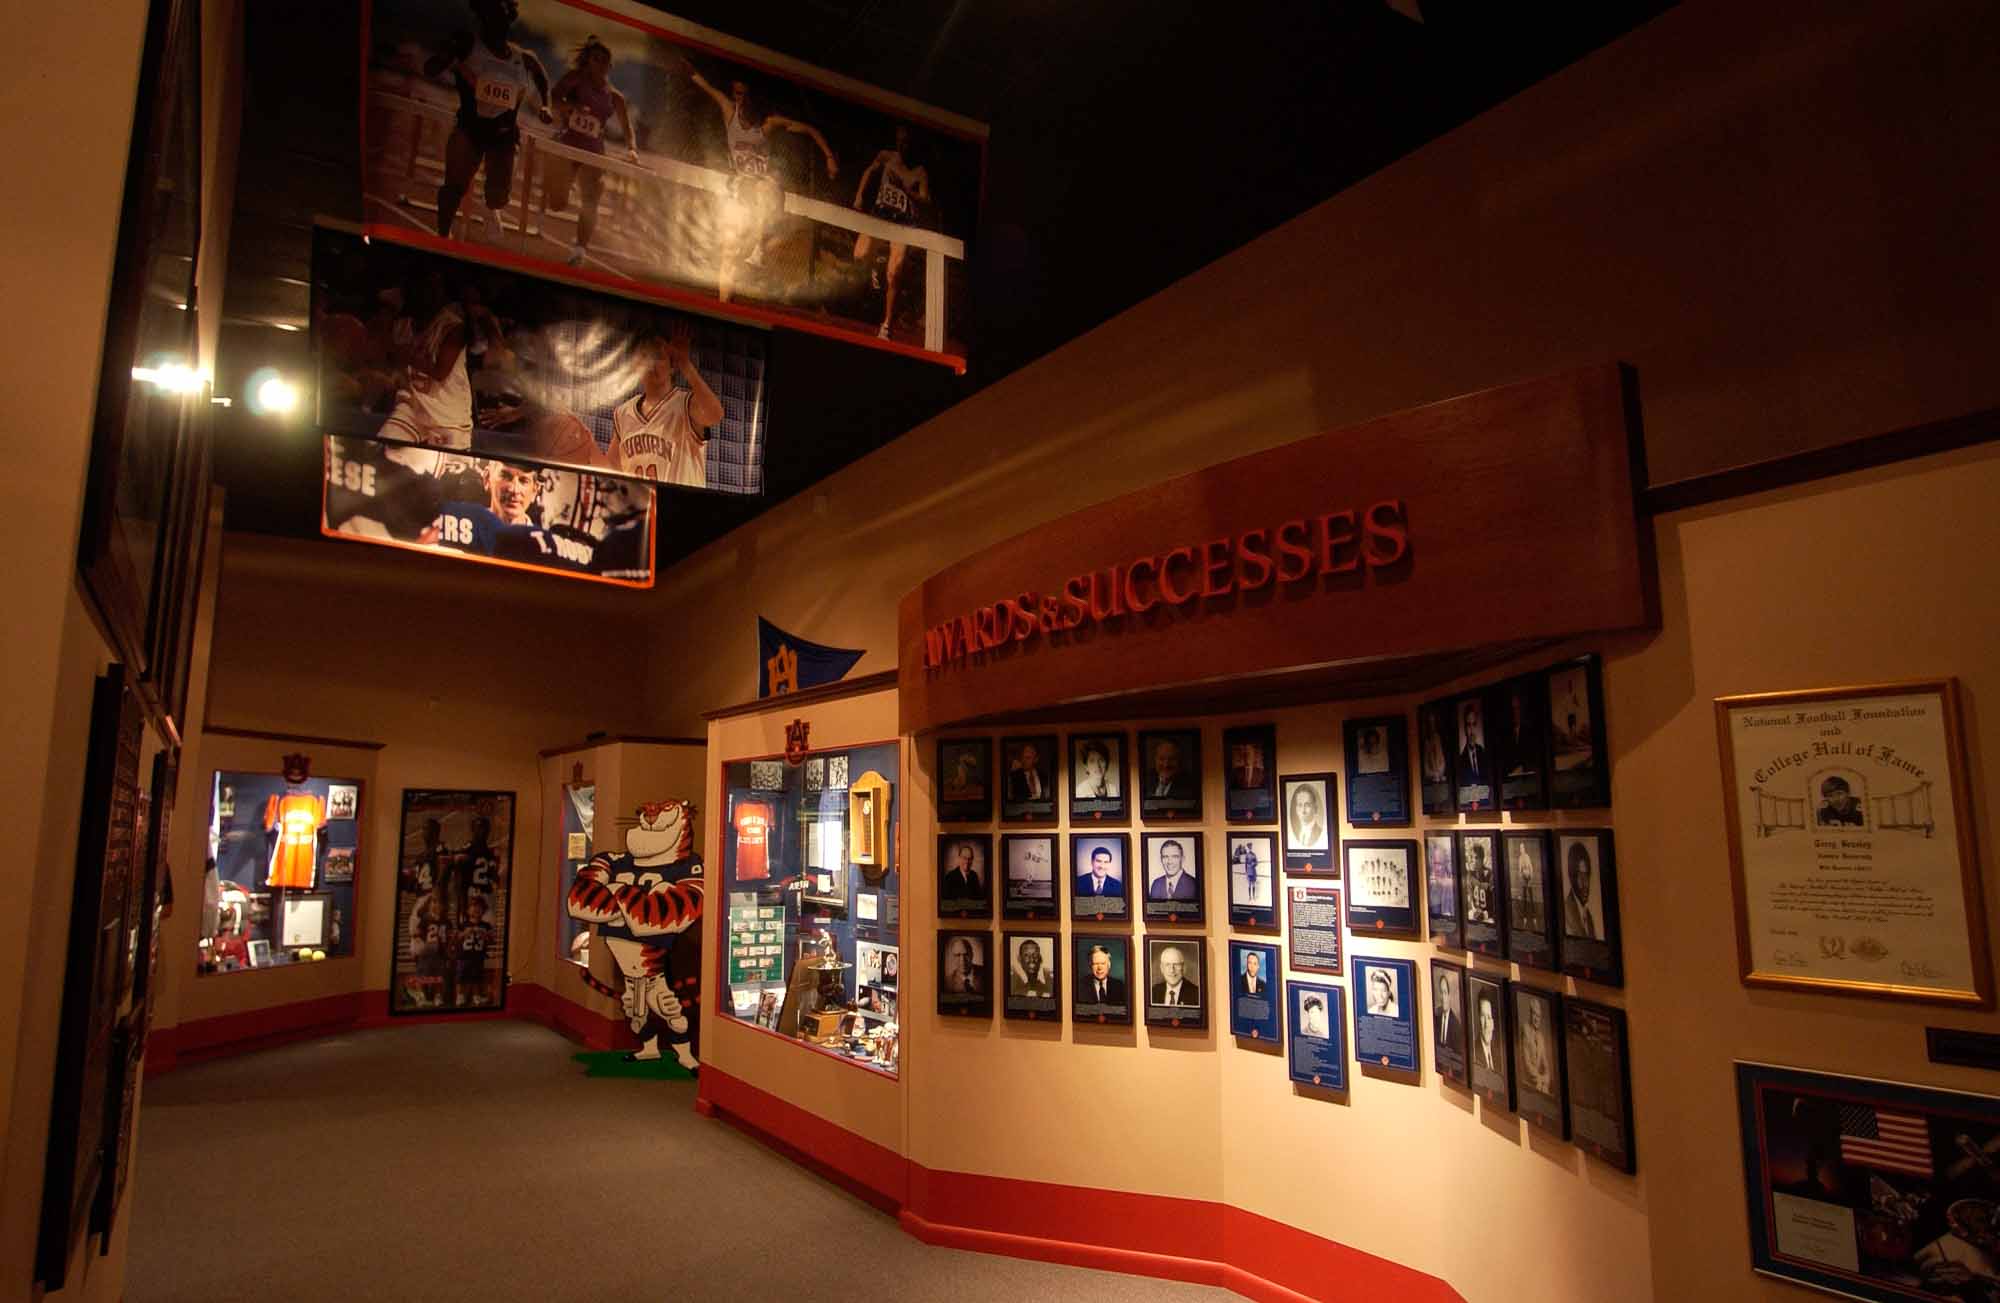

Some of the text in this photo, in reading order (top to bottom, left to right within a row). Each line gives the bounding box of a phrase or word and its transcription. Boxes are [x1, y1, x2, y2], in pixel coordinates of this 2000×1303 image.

[1063, 499, 1411, 630] SUCCESSES
[1796, 711, 1846, 724] Football
[1851, 706, 1926, 720] Foundation
[1754, 741, 1925, 784] College Hall of Fame
